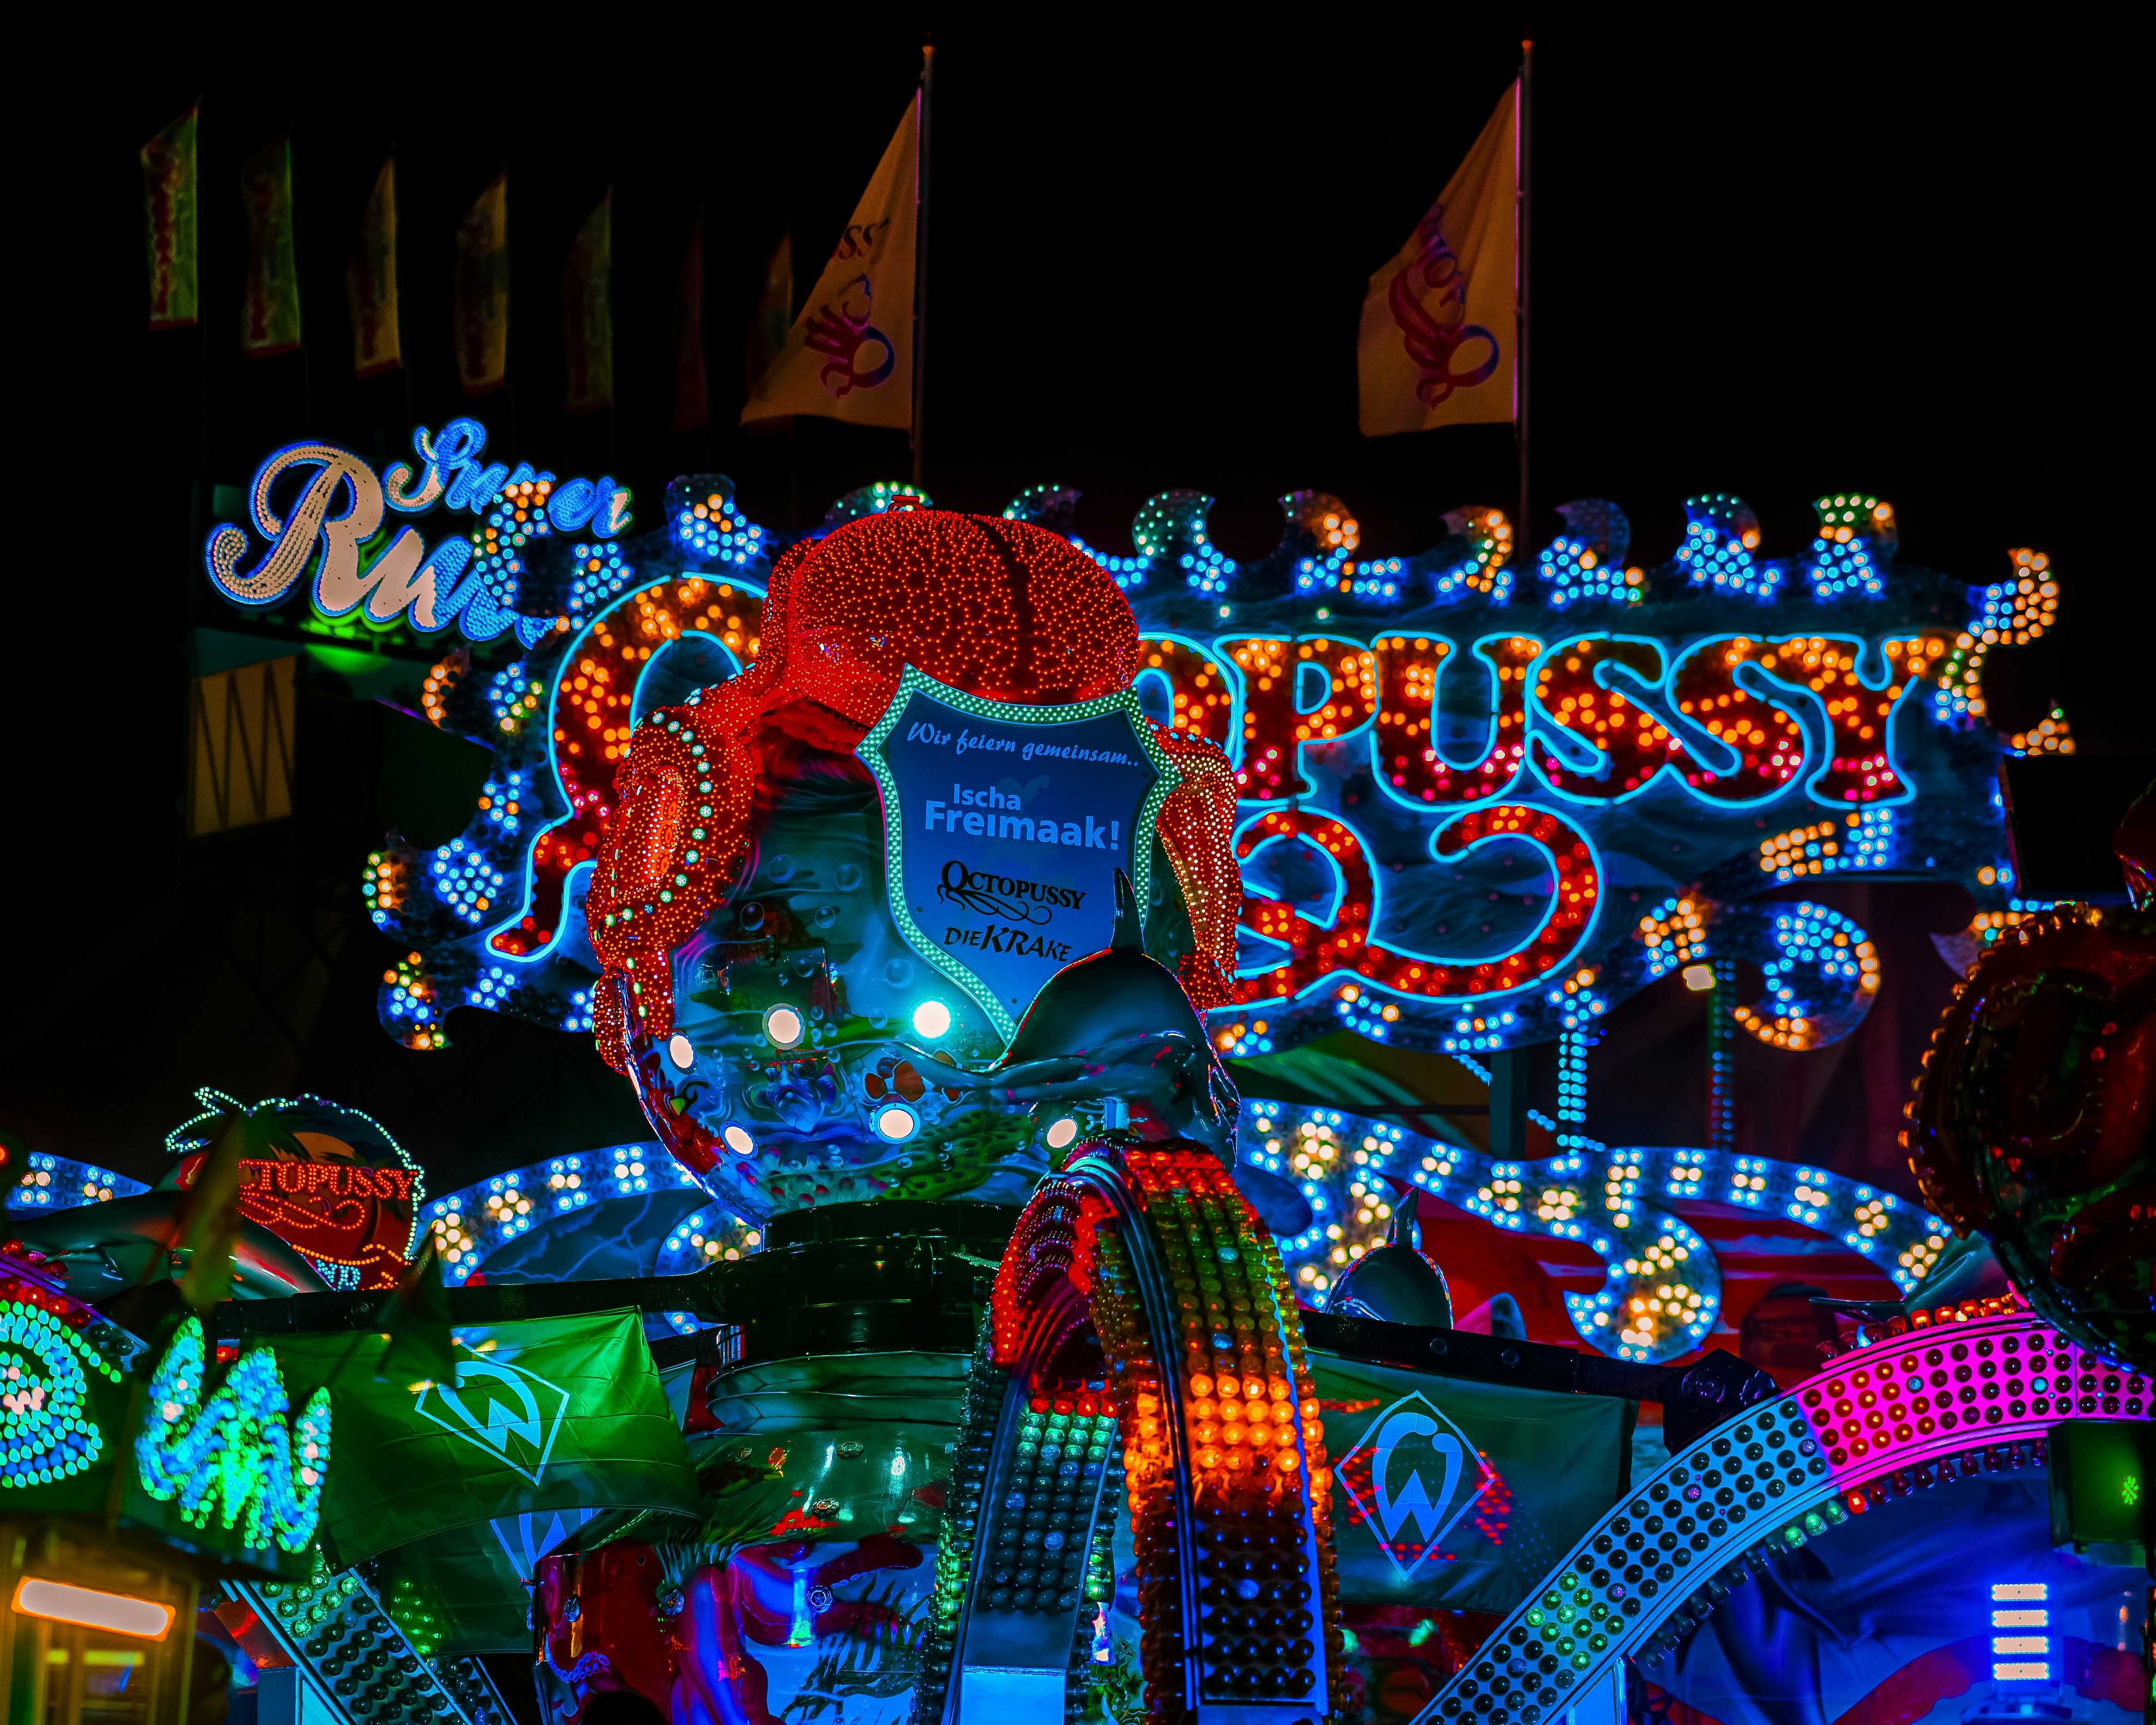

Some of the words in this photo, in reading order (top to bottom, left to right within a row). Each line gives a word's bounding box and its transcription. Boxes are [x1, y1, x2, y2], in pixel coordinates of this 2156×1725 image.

[907, 722, 951, 744] Wir
[956, 729, 1016, 755] feiern
[954, 784, 1021, 811] Ischa
[925, 800, 1119, 850] Freimaak!
[938, 860, 1087, 912] OCTOPUSSY
[238, 1158, 419, 1201] CTOPUSSY
